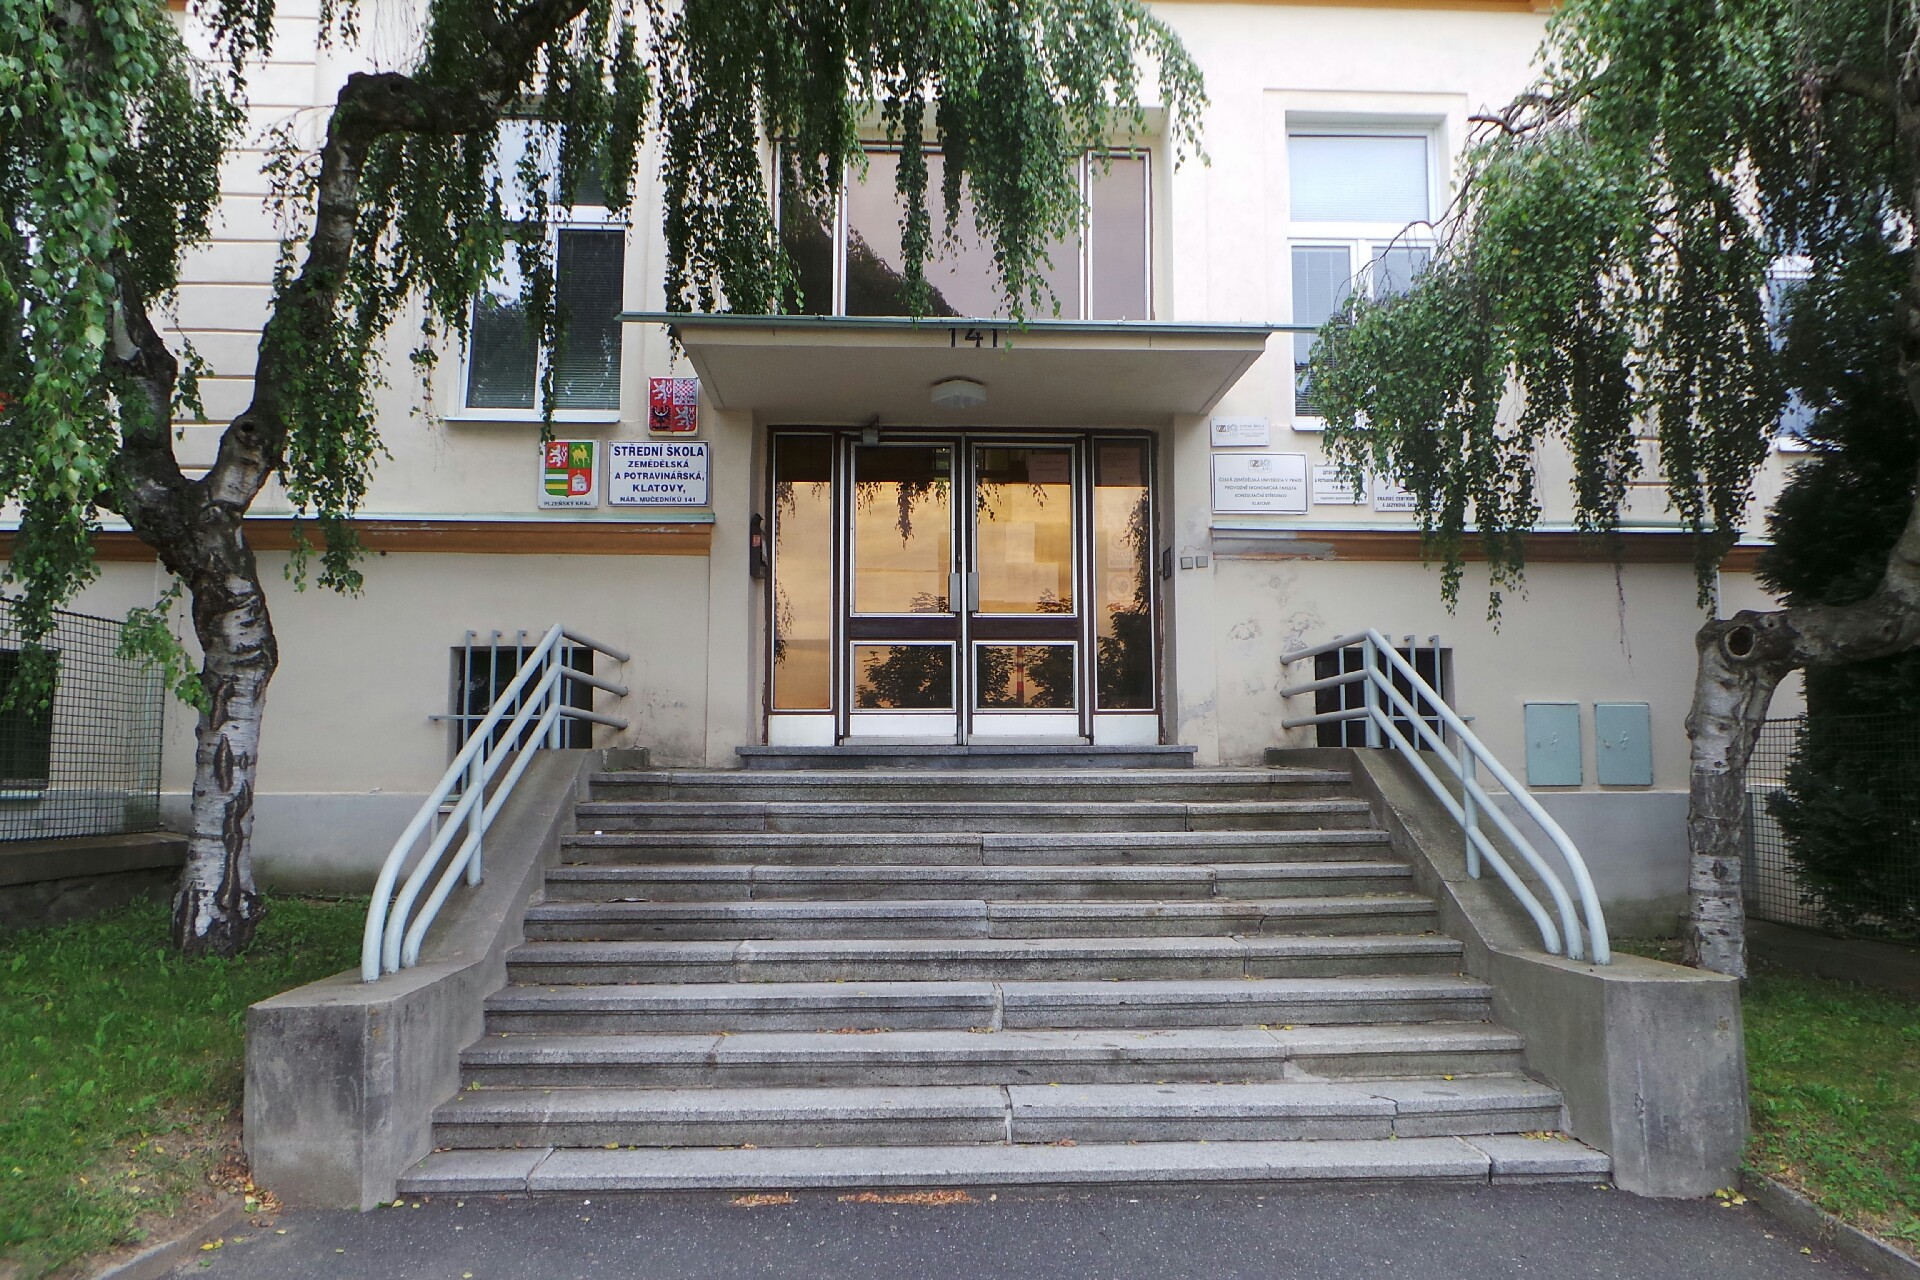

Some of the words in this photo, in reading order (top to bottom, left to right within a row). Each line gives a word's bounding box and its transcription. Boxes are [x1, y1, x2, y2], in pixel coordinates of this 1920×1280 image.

[948, 328, 998, 348] 141
[613, 443, 664, 457] STŘEDNÍ
[666, 443, 704, 457] ŠKOLA
[627, 458, 690, 468] ZEMĚDĚLSKÁ
[614, 472, 621, 480] A
[624, 470, 705, 481] POTRAVINÁŘSKÁ,
[632, 484, 686, 494] KLATOVY,
